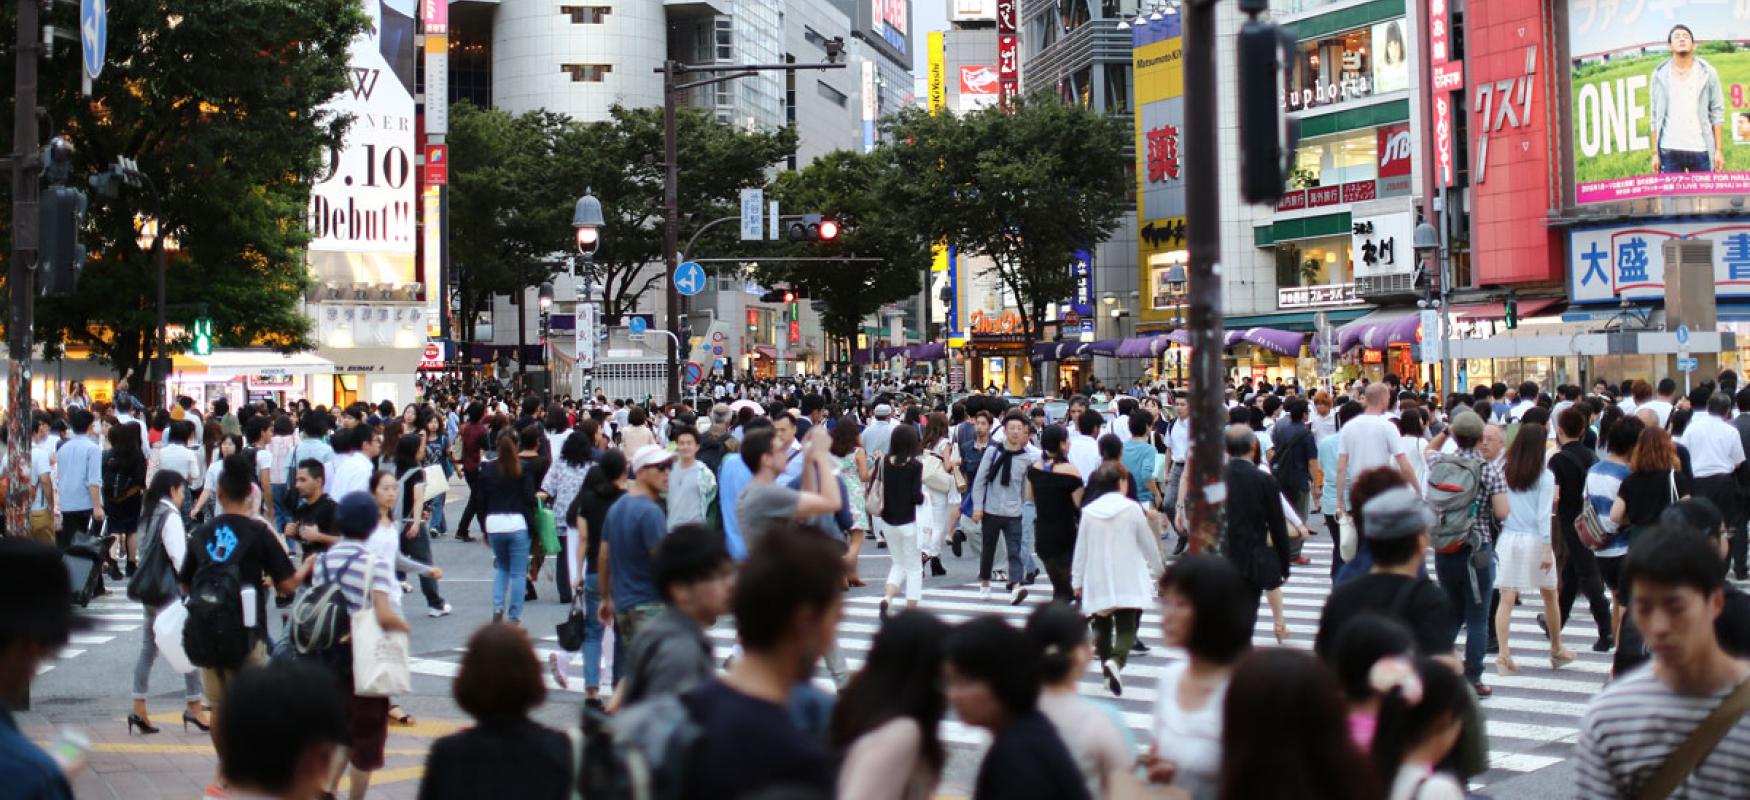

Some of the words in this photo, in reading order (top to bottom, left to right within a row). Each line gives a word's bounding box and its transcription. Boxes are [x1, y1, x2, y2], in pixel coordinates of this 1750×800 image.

[1578, 75, 1649, 158] ONE
[1146, 124, 1179, 184] 薬
[1380, 131, 1411, 167] JTB
[313, 194, 409, 242] Debut!!
[1581, 233, 1750, 287] 大盛書
